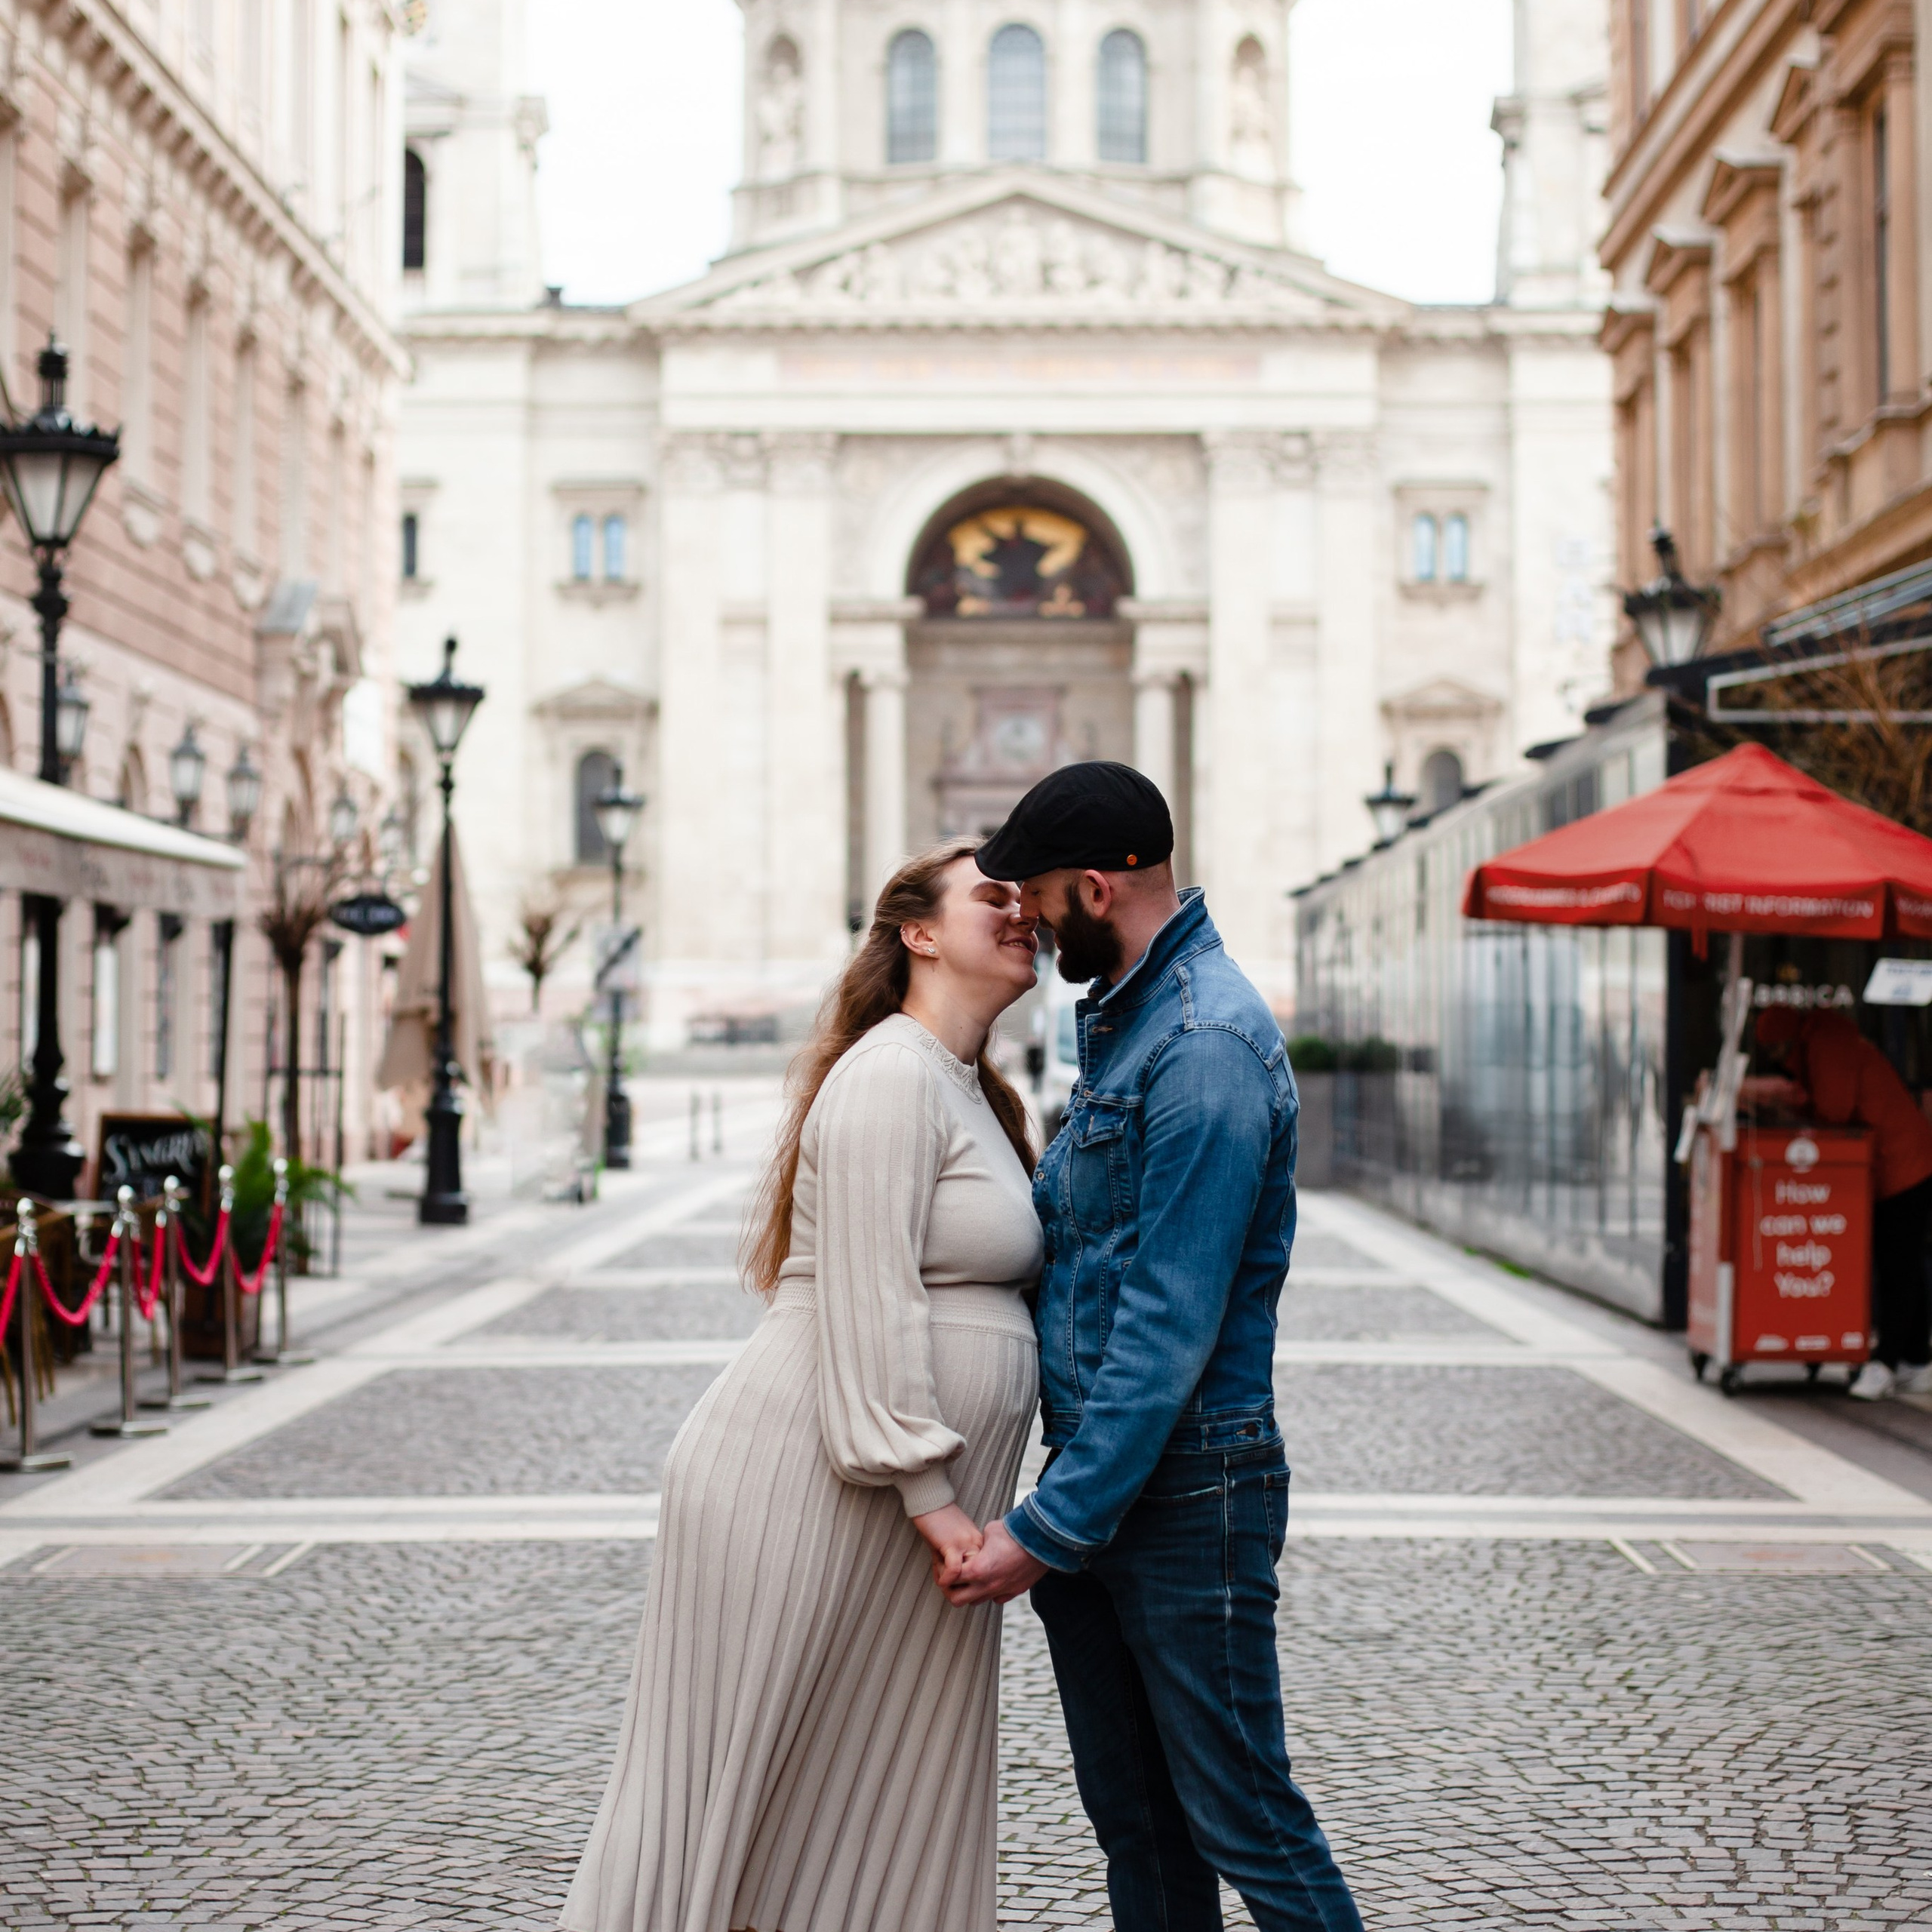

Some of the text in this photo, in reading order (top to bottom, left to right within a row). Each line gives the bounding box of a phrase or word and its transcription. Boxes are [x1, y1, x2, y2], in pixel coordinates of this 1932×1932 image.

[1745, 895, 1874, 918] INFORMATION
[1775, 1179, 1831, 1204] How
[1760, 1214, 1847, 1236] can we
[1777, 1240, 1832, 1272] help
[1774, 1271, 1835, 1298] You?
